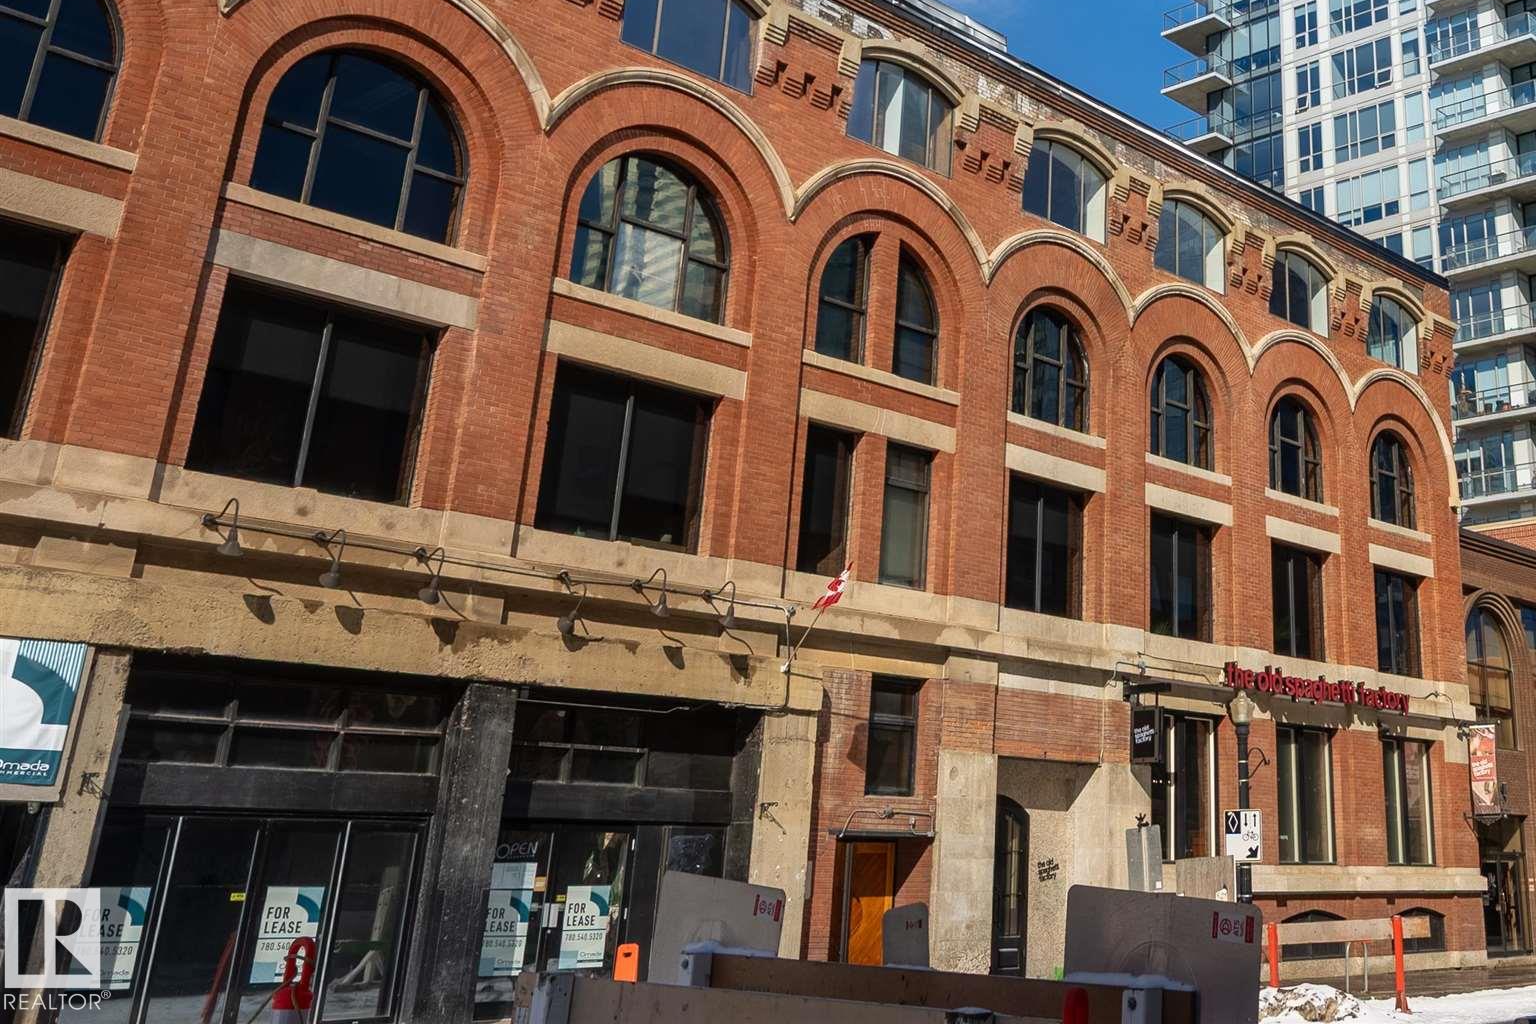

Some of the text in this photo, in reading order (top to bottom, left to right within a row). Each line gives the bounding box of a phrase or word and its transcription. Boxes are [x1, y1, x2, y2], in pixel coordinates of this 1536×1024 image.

[1226, 662, 1410, 717] the old spaghetti factory
[497, 841, 539, 858] OPEN
[266, 907, 290, 919] FOR
[567, 903, 587, 914] FOR
[566, 915, 596, 927] LEASE
[263, 921, 302, 934] LEASE
